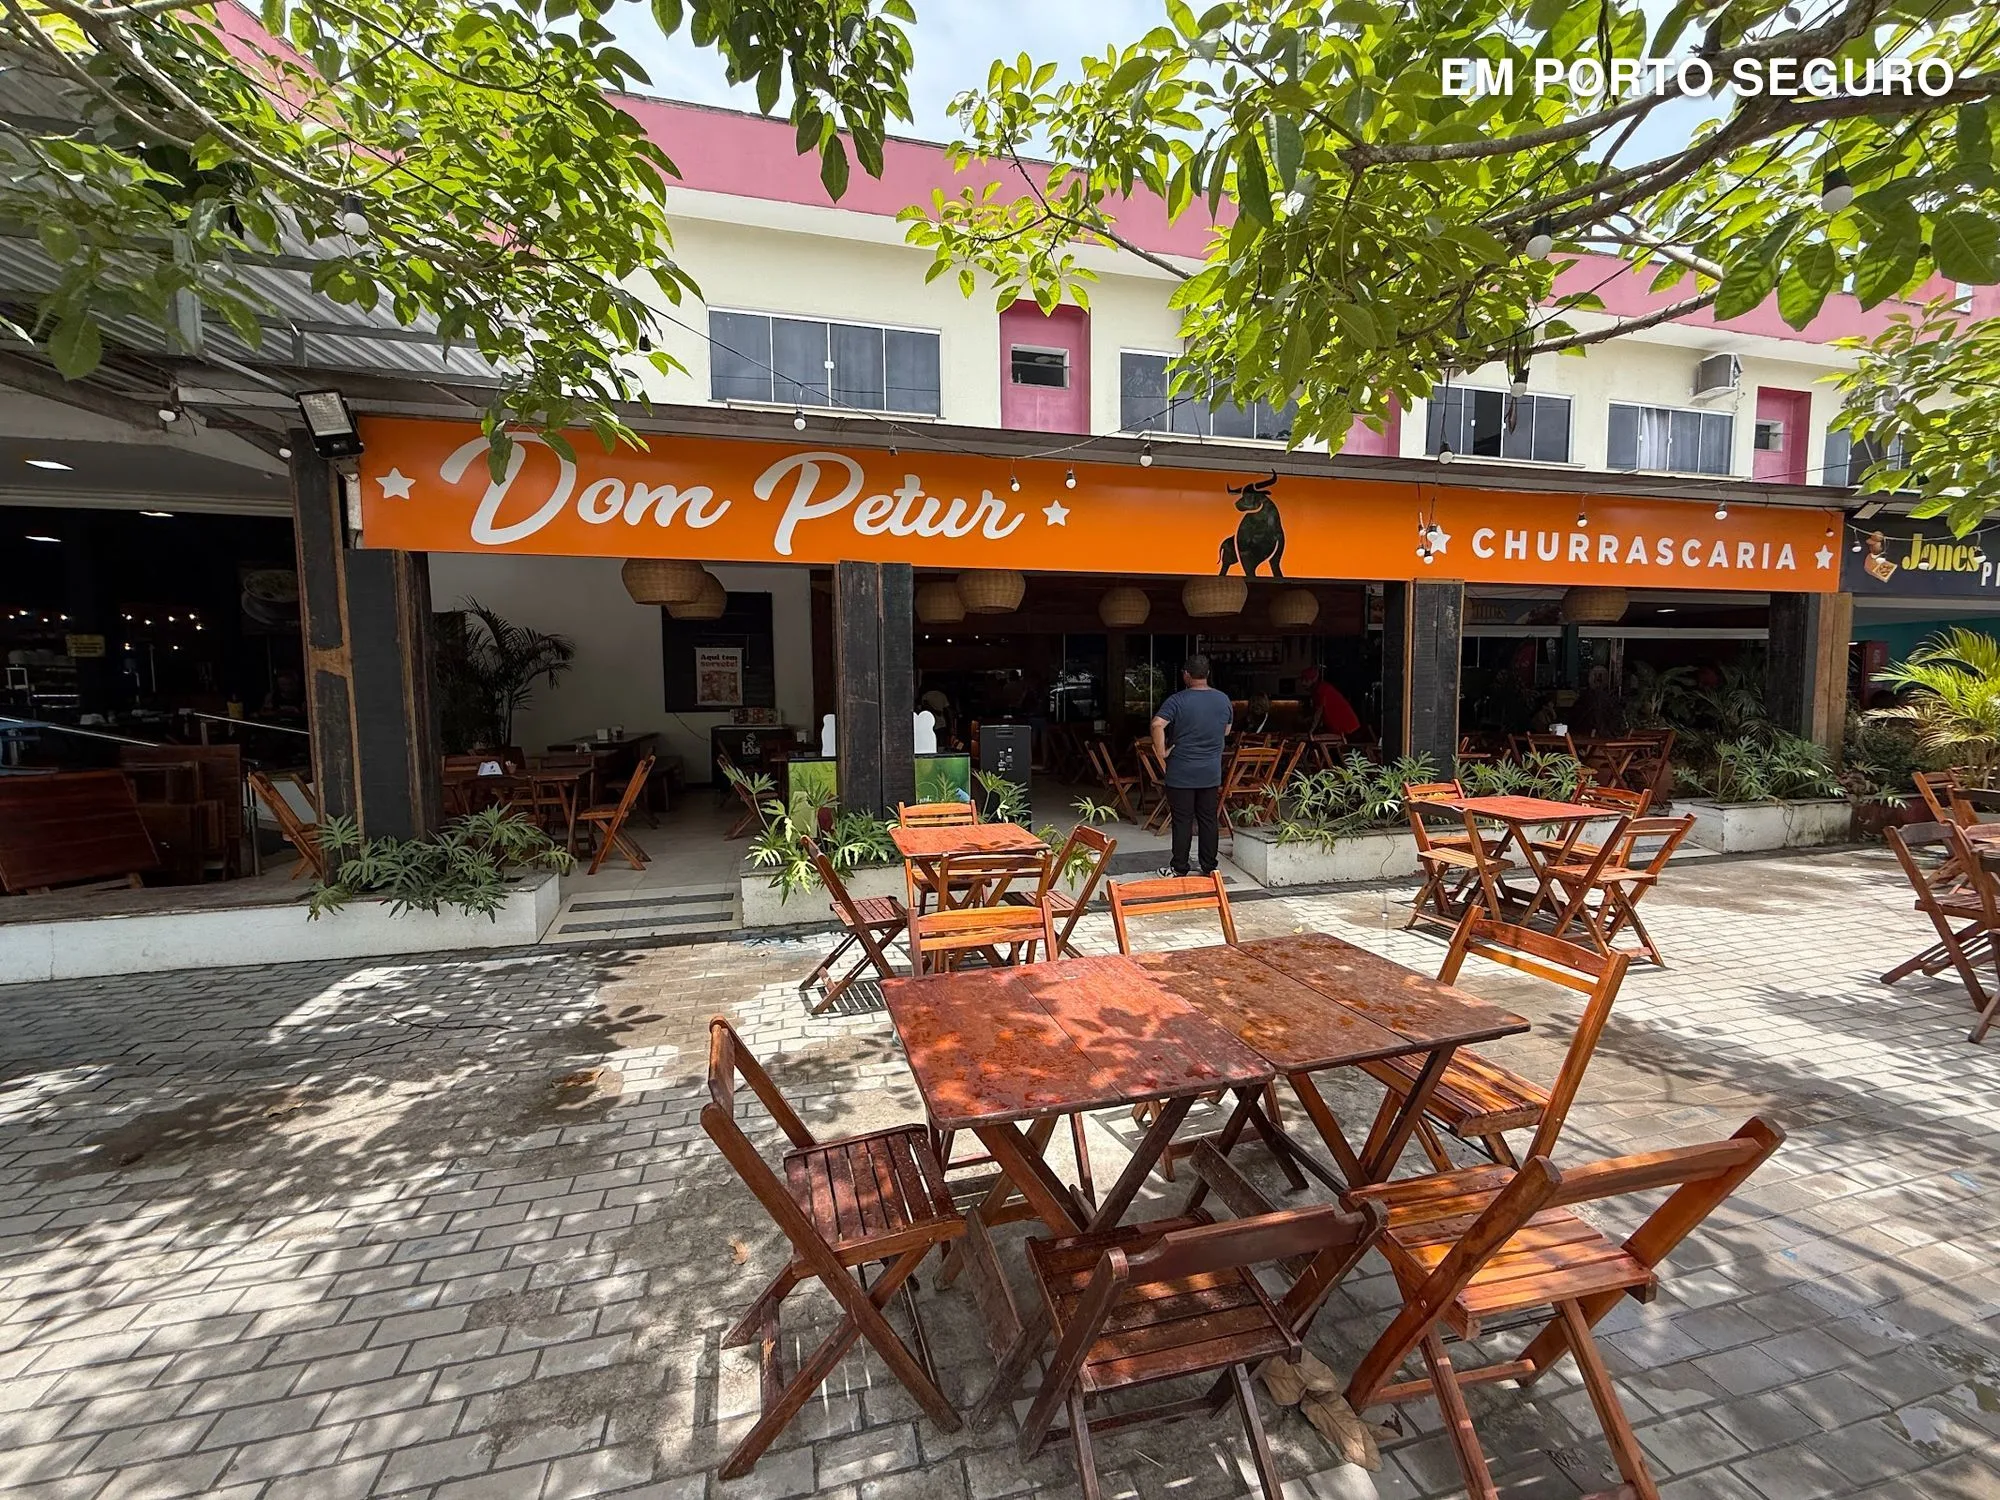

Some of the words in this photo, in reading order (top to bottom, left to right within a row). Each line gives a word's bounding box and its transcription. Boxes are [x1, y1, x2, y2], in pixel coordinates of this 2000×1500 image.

[440, 431, 732, 545] Dom
[753, 451, 1026, 556] Petur
[1471, 527, 1797, 571] CHURRASCARIA
[1901, 533, 1981, 572] Jones
